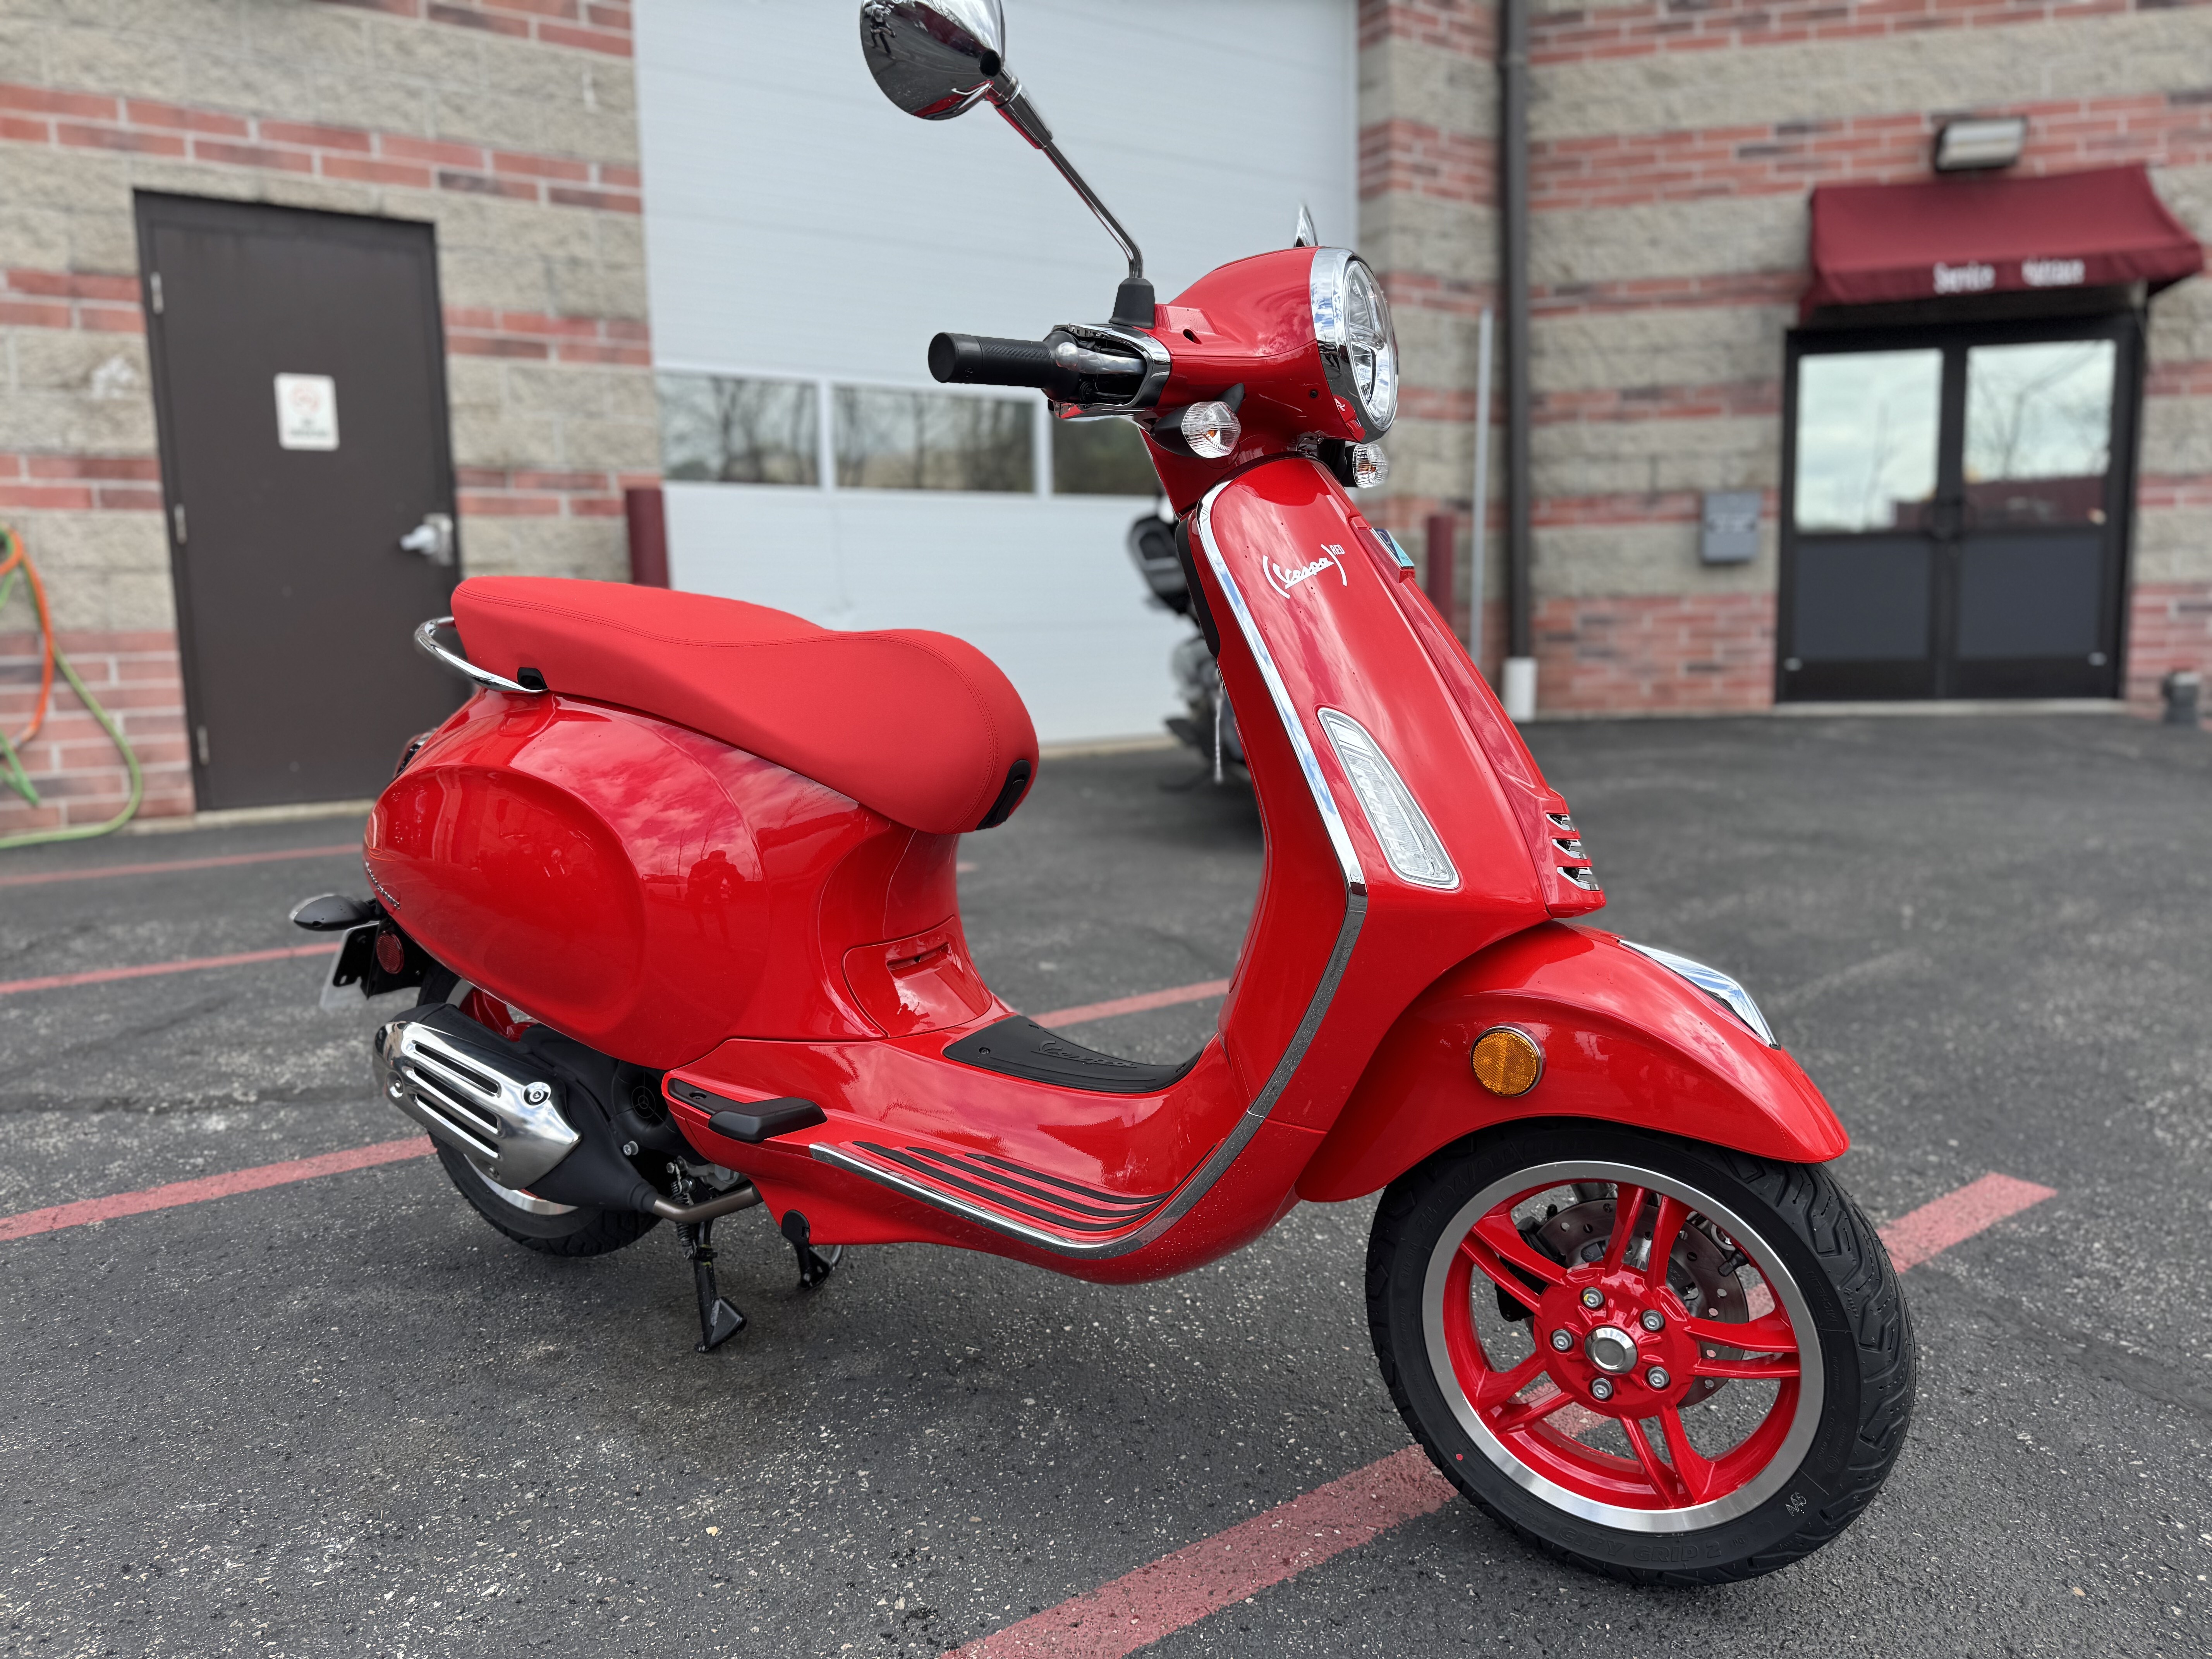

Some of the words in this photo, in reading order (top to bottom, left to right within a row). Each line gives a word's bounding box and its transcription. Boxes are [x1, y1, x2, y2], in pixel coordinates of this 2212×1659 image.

[1330, 544, 1345, 556] RED
[1559, 1527, 1626, 1556] CITY
[1633, 1544, 1699, 1562] GRIP
